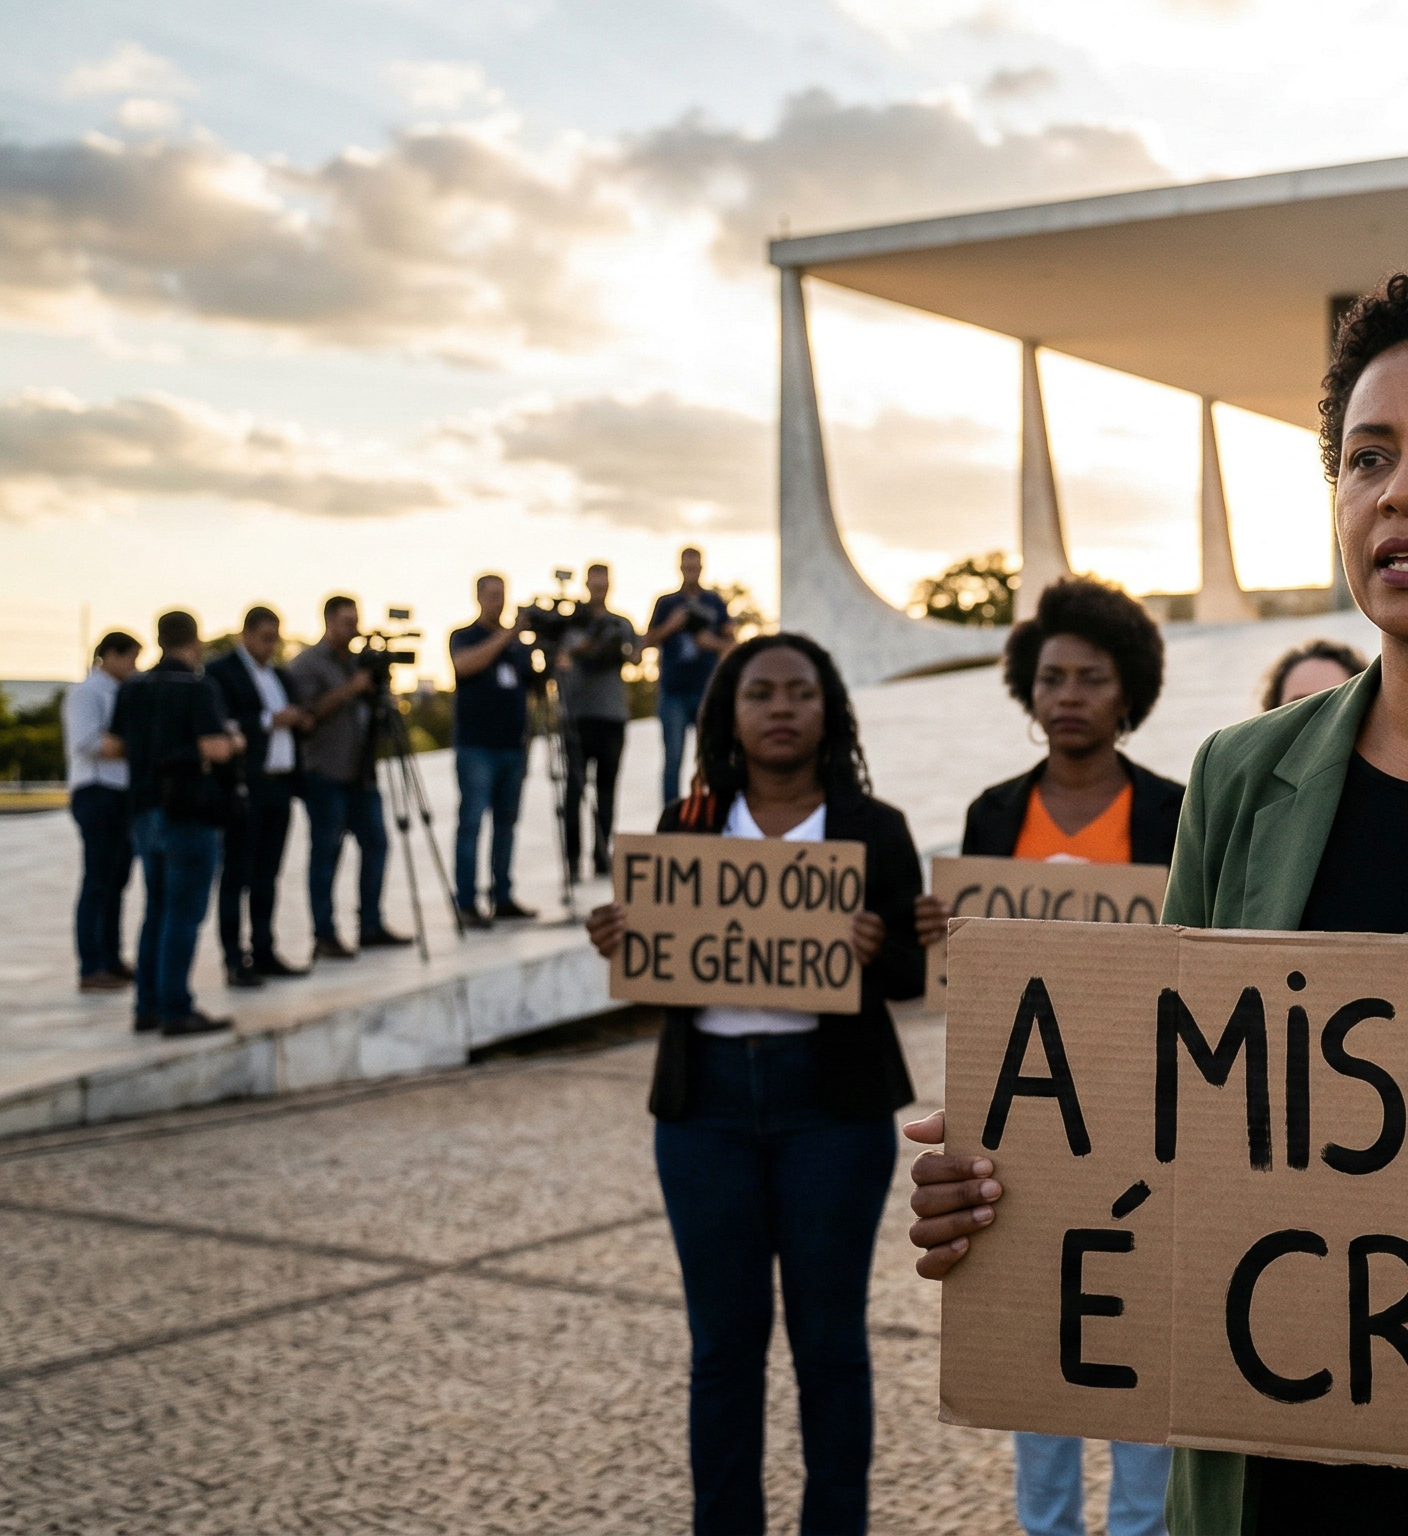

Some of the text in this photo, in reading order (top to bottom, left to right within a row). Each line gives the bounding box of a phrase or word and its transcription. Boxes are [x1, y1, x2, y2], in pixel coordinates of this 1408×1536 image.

[623, 850, 863, 914] FIM DO ÓDIO
[623, 919, 854, 989] DE GÊNERO
[981, 976, 1092, 1158] A
[1059, 1179, 1152, 1390] É
